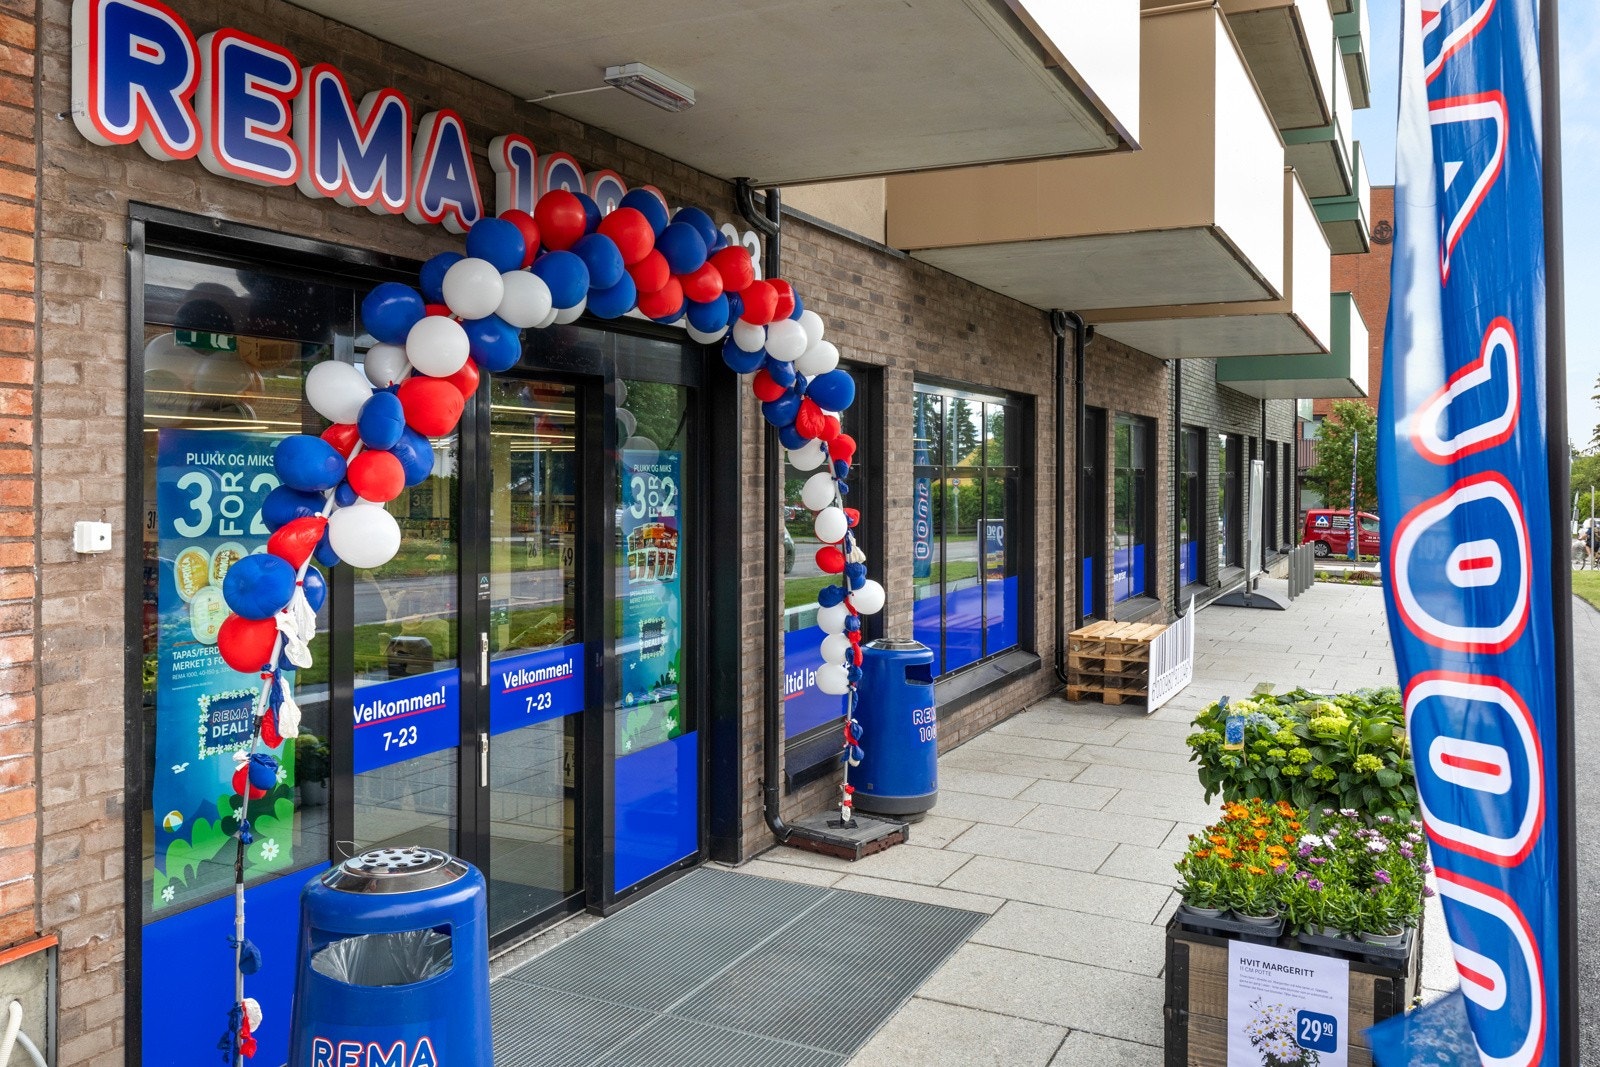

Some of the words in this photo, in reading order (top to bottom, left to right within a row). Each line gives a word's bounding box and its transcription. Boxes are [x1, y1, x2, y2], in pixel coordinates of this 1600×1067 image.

[72, 0, 484, 234] REMA
[186, 452, 226, 466] PLUKK
[228, 453, 245, 466] OG
[173, 471, 213, 538] 3
[219, 471, 245, 536] FOR
[630, 476, 647, 519] 3
[648, 476, 659, 518] FOR
[661, 476, 676, 517] 2
[172, 659, 206, 672] MERKET
[207, 657, 213, 667] 3
[214, 656, 227, 666] FO
[503, 658, 573, 689] Velkommen!
[784, 669, 804, 695] ltid
[353, 685, 447, 724] Velkommen!
[525, 691, 552, 714] 7-23
[212, 708, 249, 723] REMA
[212, 719, 249, 739] DEAL!
[383, 725, 418, 752] 7-23
[1240, 957, 1261, 968] HVIT
[1262, 961, 1315, 978] MARGERITT
[1254, 969, 1272, 977] POTTE
